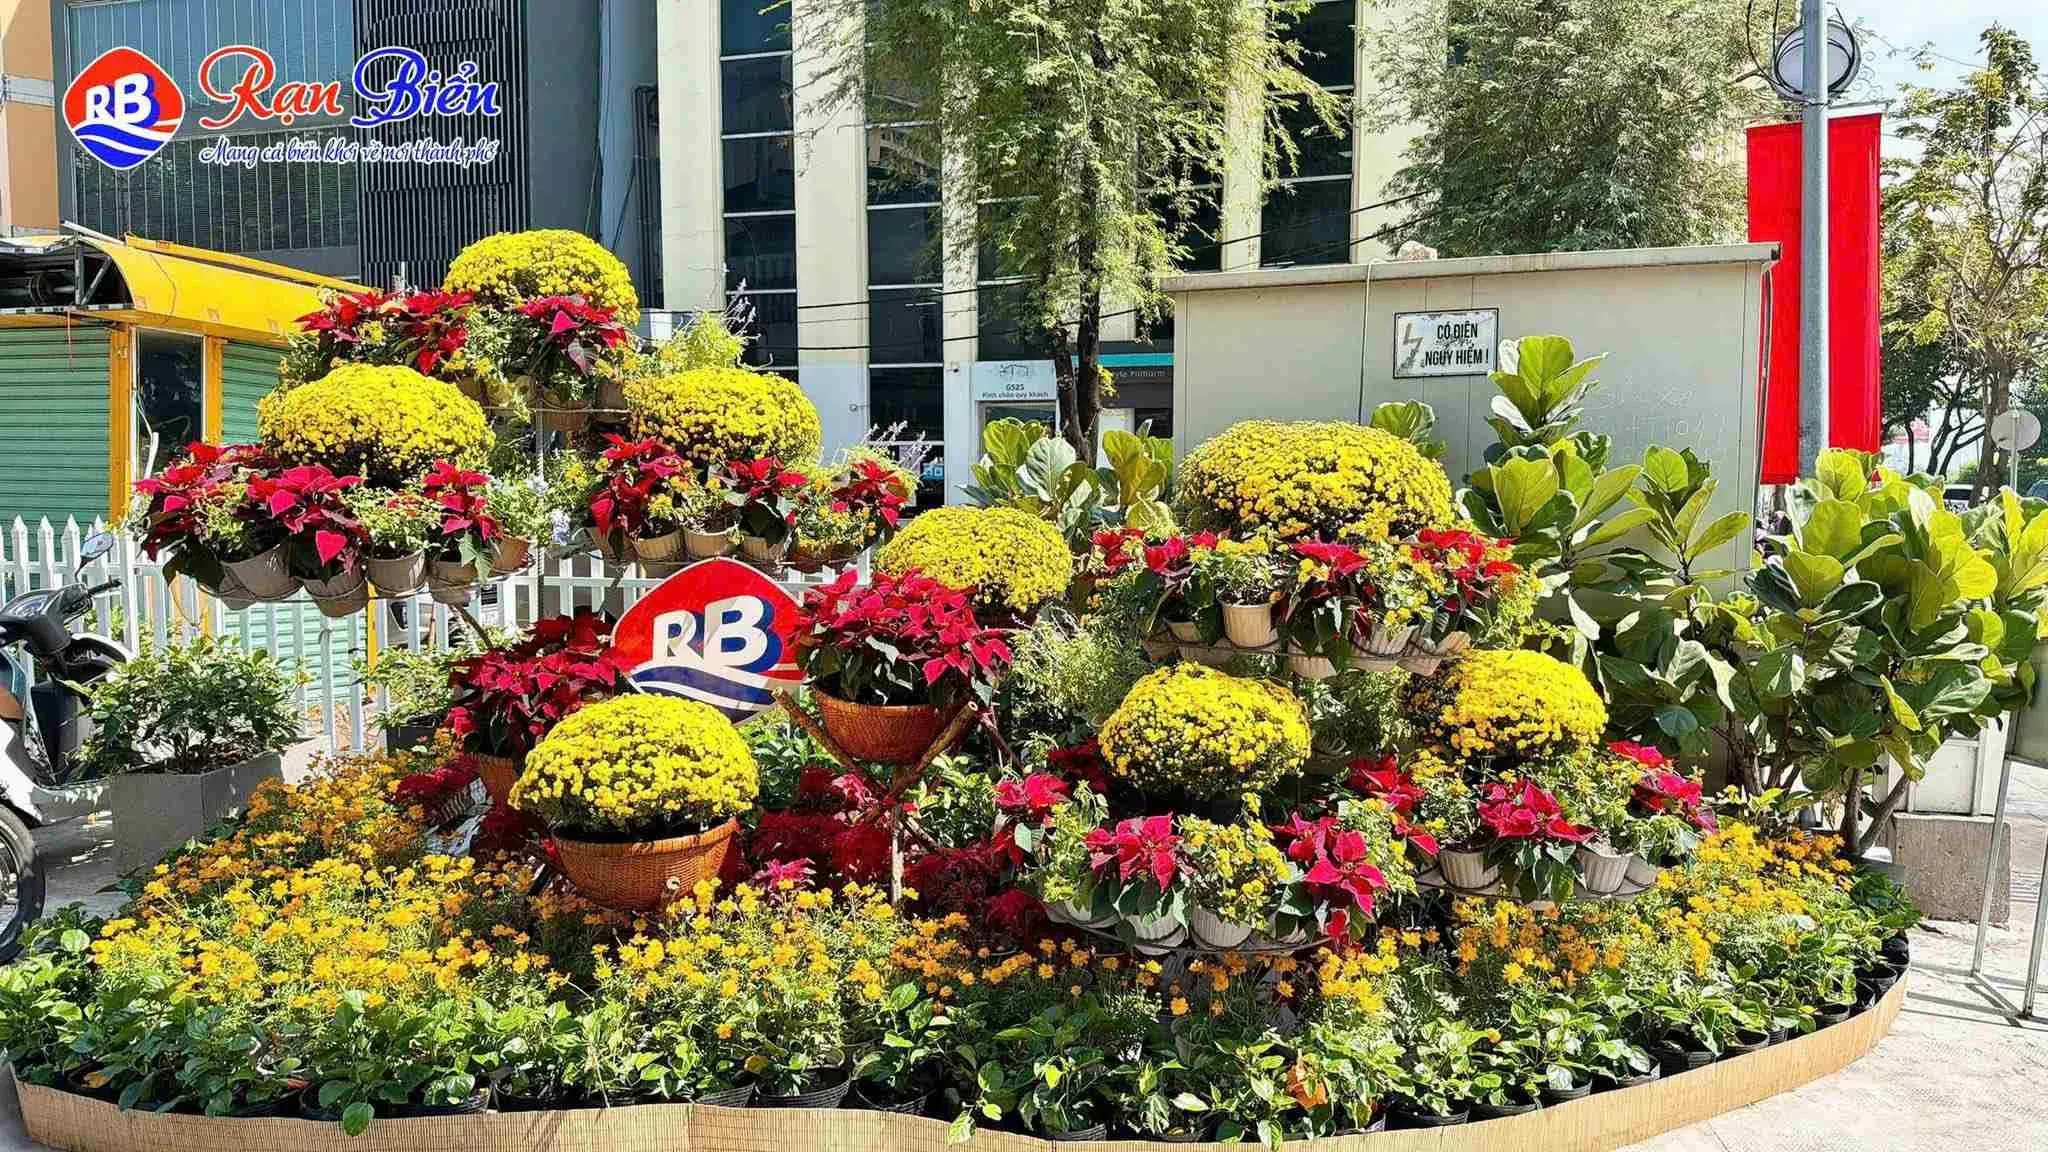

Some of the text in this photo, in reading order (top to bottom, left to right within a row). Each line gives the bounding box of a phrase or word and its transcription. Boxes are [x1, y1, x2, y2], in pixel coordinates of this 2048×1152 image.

[1437, 321, 1451, 340] CÓ
[1425, 350, 1453, 367] NGUY
[652, 595, 768, 668] RB
